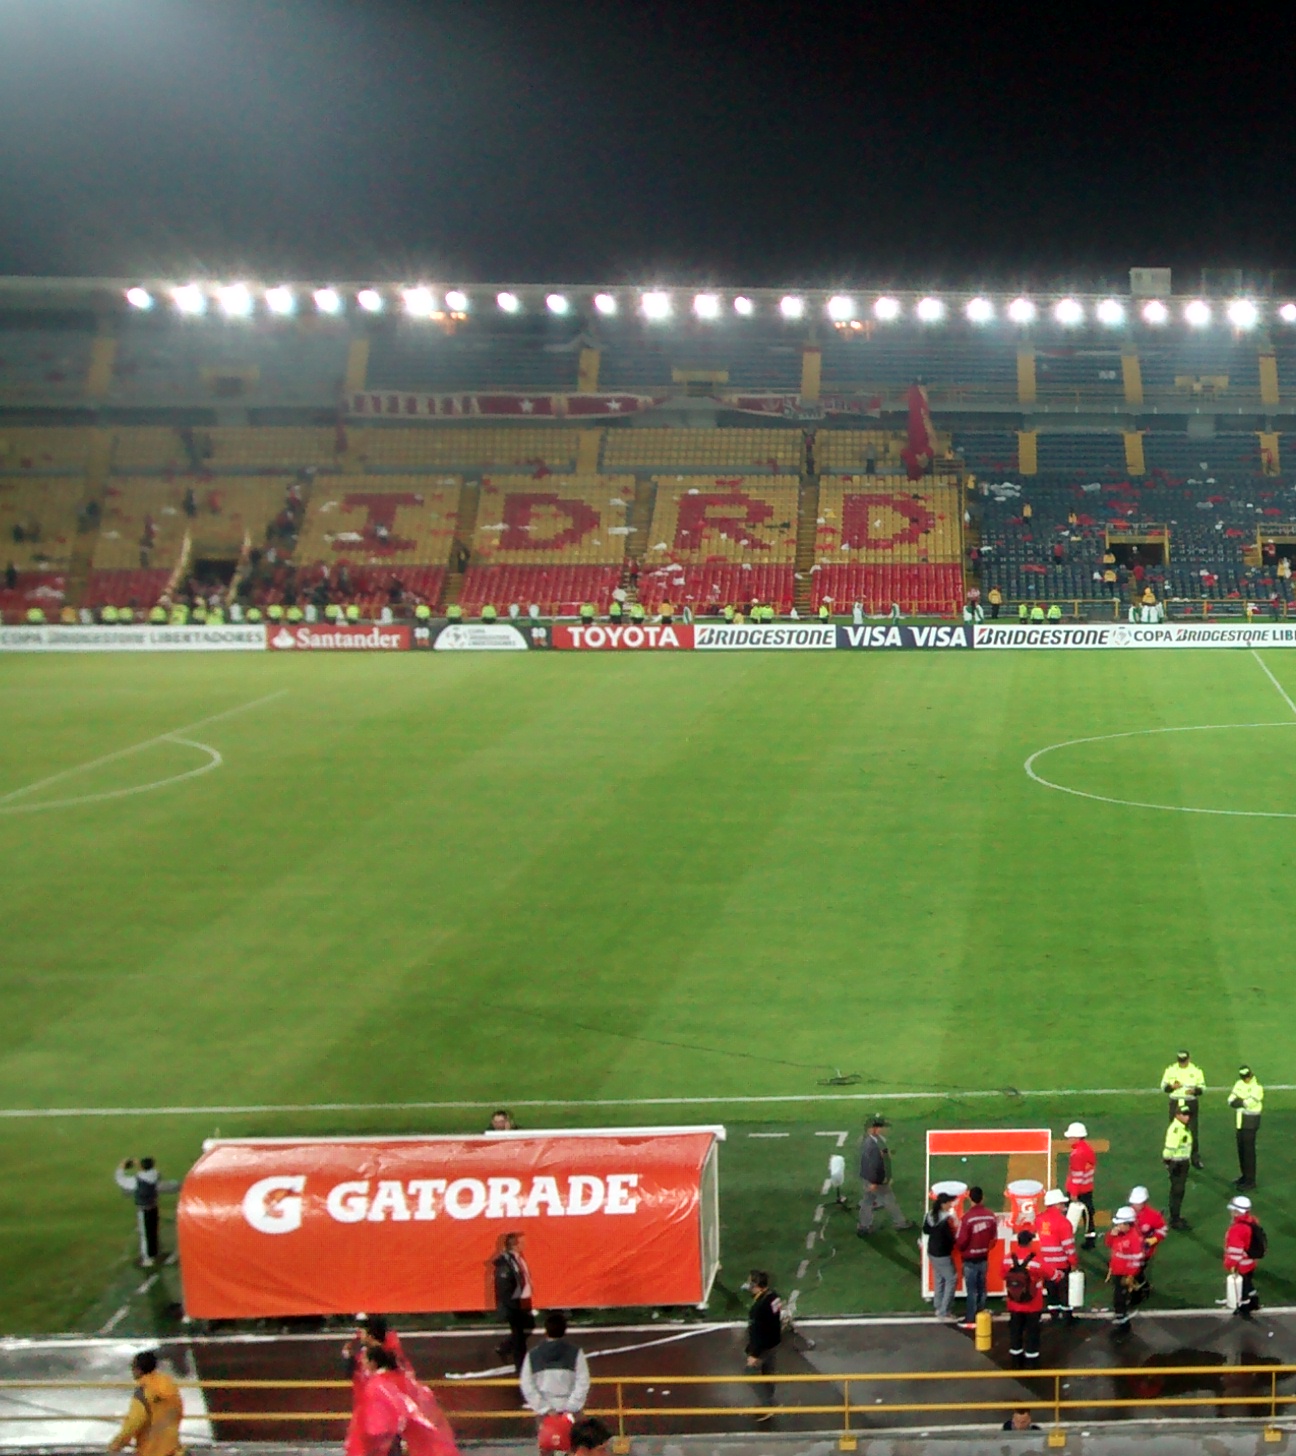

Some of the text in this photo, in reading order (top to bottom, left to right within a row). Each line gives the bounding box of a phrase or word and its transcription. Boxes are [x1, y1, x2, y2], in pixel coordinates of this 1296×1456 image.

[296, 626, 401, 648] Santander
[567, 626, 679, 648] TOYOTA
[697, 627, 833, 646] BRIDGESTONE
[843, 626, 967, 647] VISA VISA
[976, 627, 1109, 646] BRIDGESTONE
[1134, 631, 1173, 642] COPA
[1175, 628, 1269, 642] BRIDGESTONE
[243, 1173, 640, 1234] G GATORADE
[1020, 1200, 1035, 1213] G
